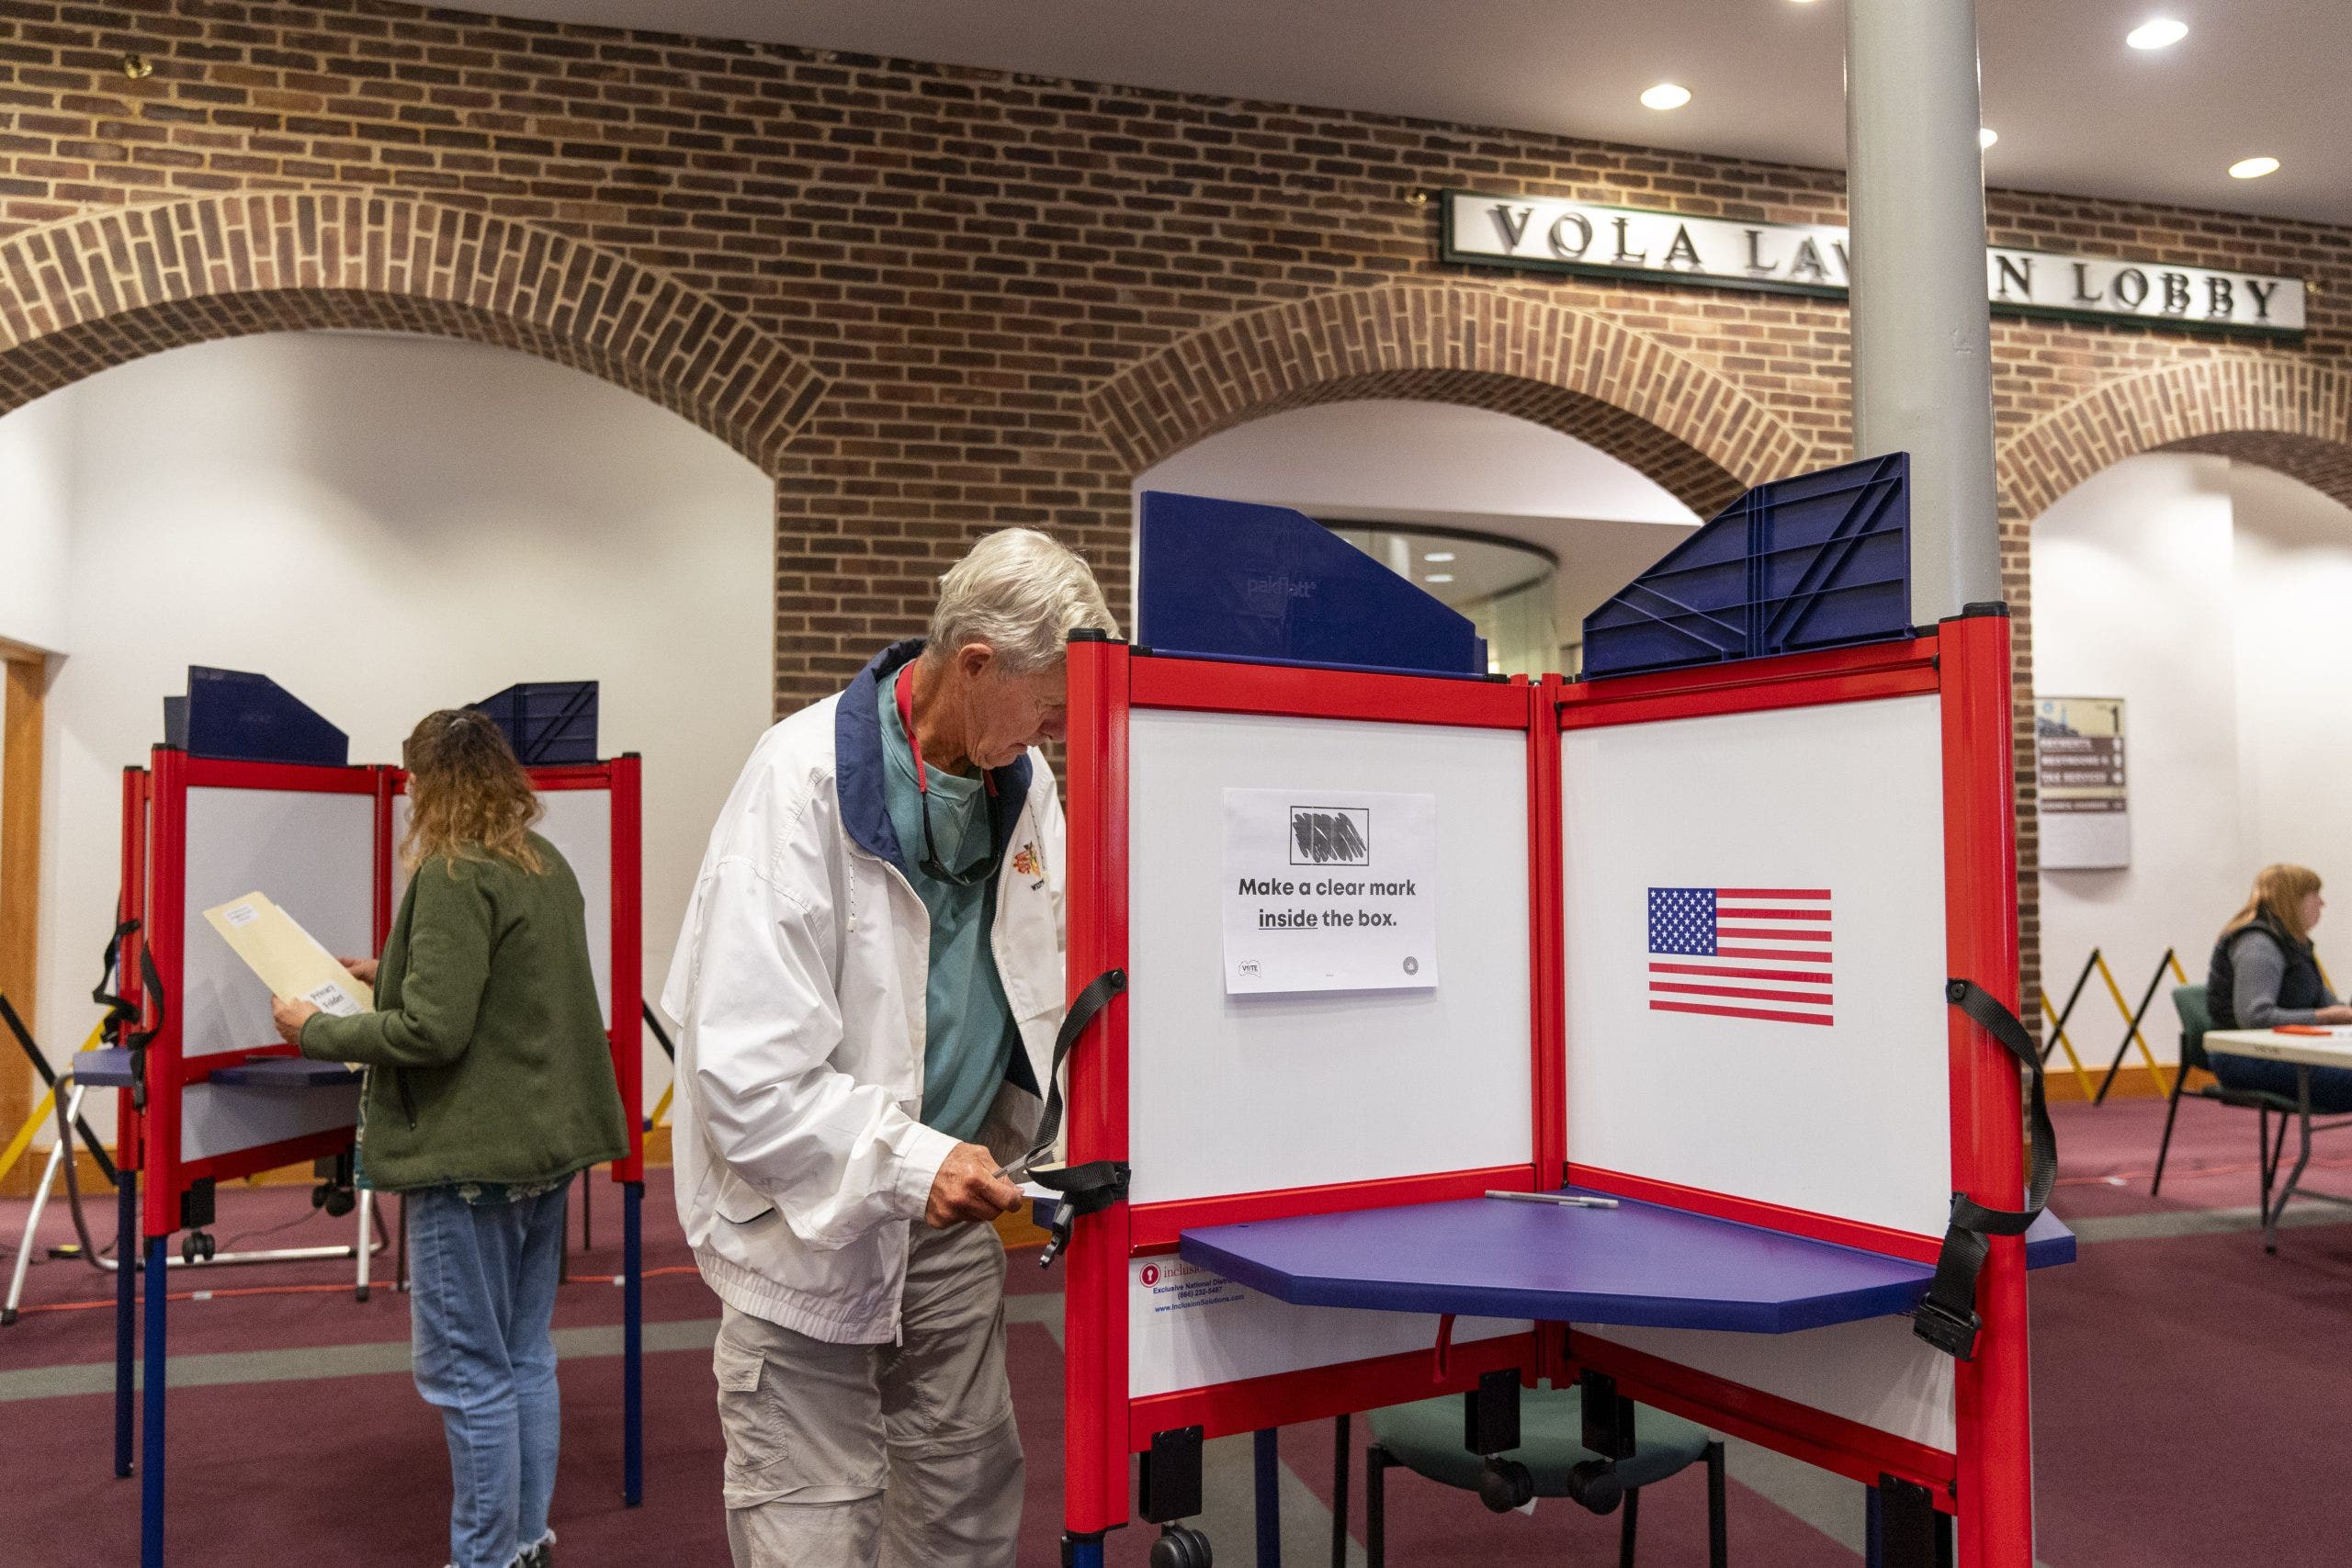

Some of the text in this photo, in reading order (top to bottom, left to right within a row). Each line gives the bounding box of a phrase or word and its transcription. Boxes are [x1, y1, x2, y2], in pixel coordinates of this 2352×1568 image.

[1493, 204, 1703, 264] VOLA
[2072, 263, 2279, 318] LOBBY
[1238, 877, 1417, 897] Make a clear mark
[1259, 908, 1397, 930] inside the box.
[1153, 1285, 1183, 1294] Exclusive
[1186, 1280, 1212, 1289] National
[1155, 1294, 1244, 1312] www.InclusionSolutions.com
